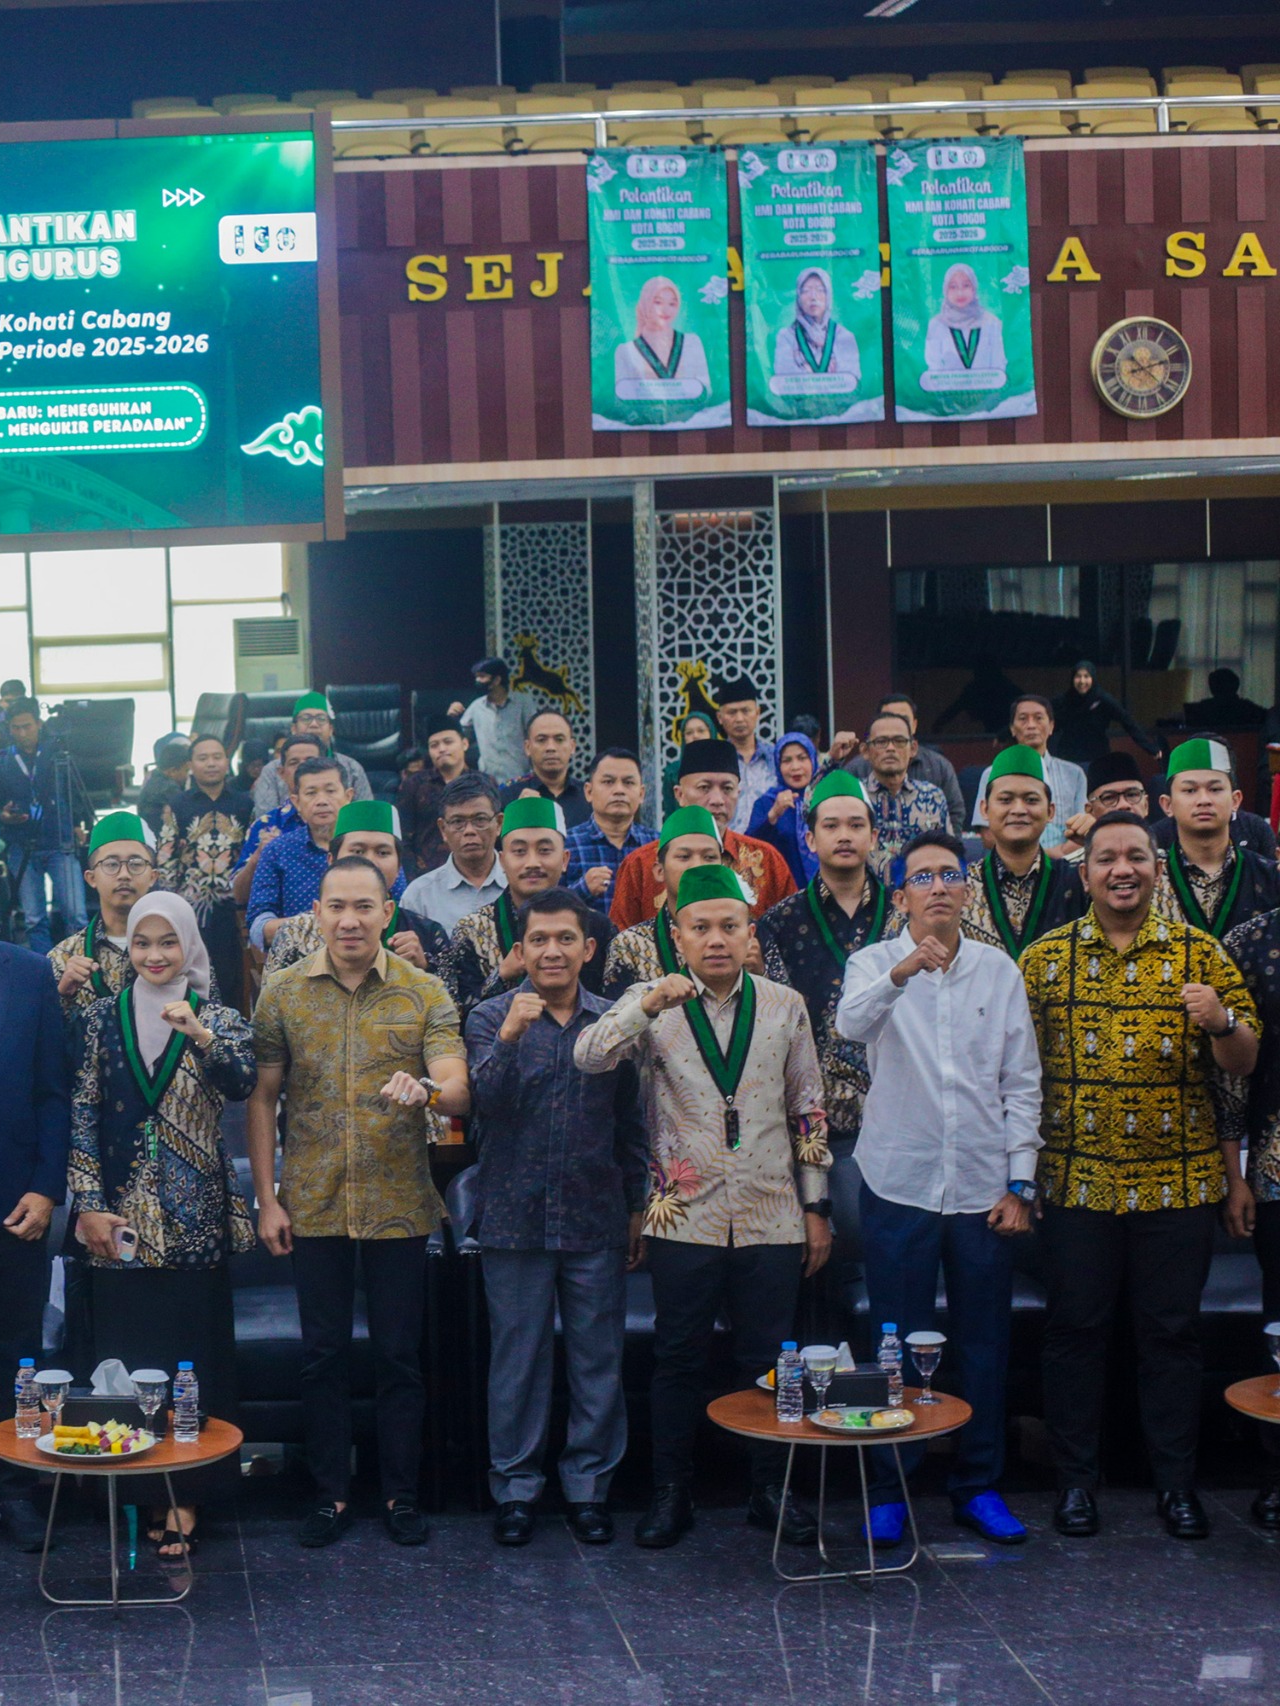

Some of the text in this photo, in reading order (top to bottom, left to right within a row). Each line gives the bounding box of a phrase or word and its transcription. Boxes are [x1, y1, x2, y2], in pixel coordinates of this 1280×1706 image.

[619, 186, 693, 204] Pelantikan
[771, 181, 844, 199] Pelantikan
[921, 177, 992, 195] Pelantikan
[905, 197, 1011, 213] HMI DAN KOHATI CABANG
[783, 217, 806, 230] KOTA
[931, 212, 986, 226] KOTA BOGOR
[631, 222, 654, 235] KOTA
[406, 252, 591, 303] SEJ
[81, 309, 171, 332] Cabang
[91, 334, 210, 357] 2025-2026
[47, 401, 152, 419] MENEGUHKAN
[8, 420, 89, 437] MENGUKIR
